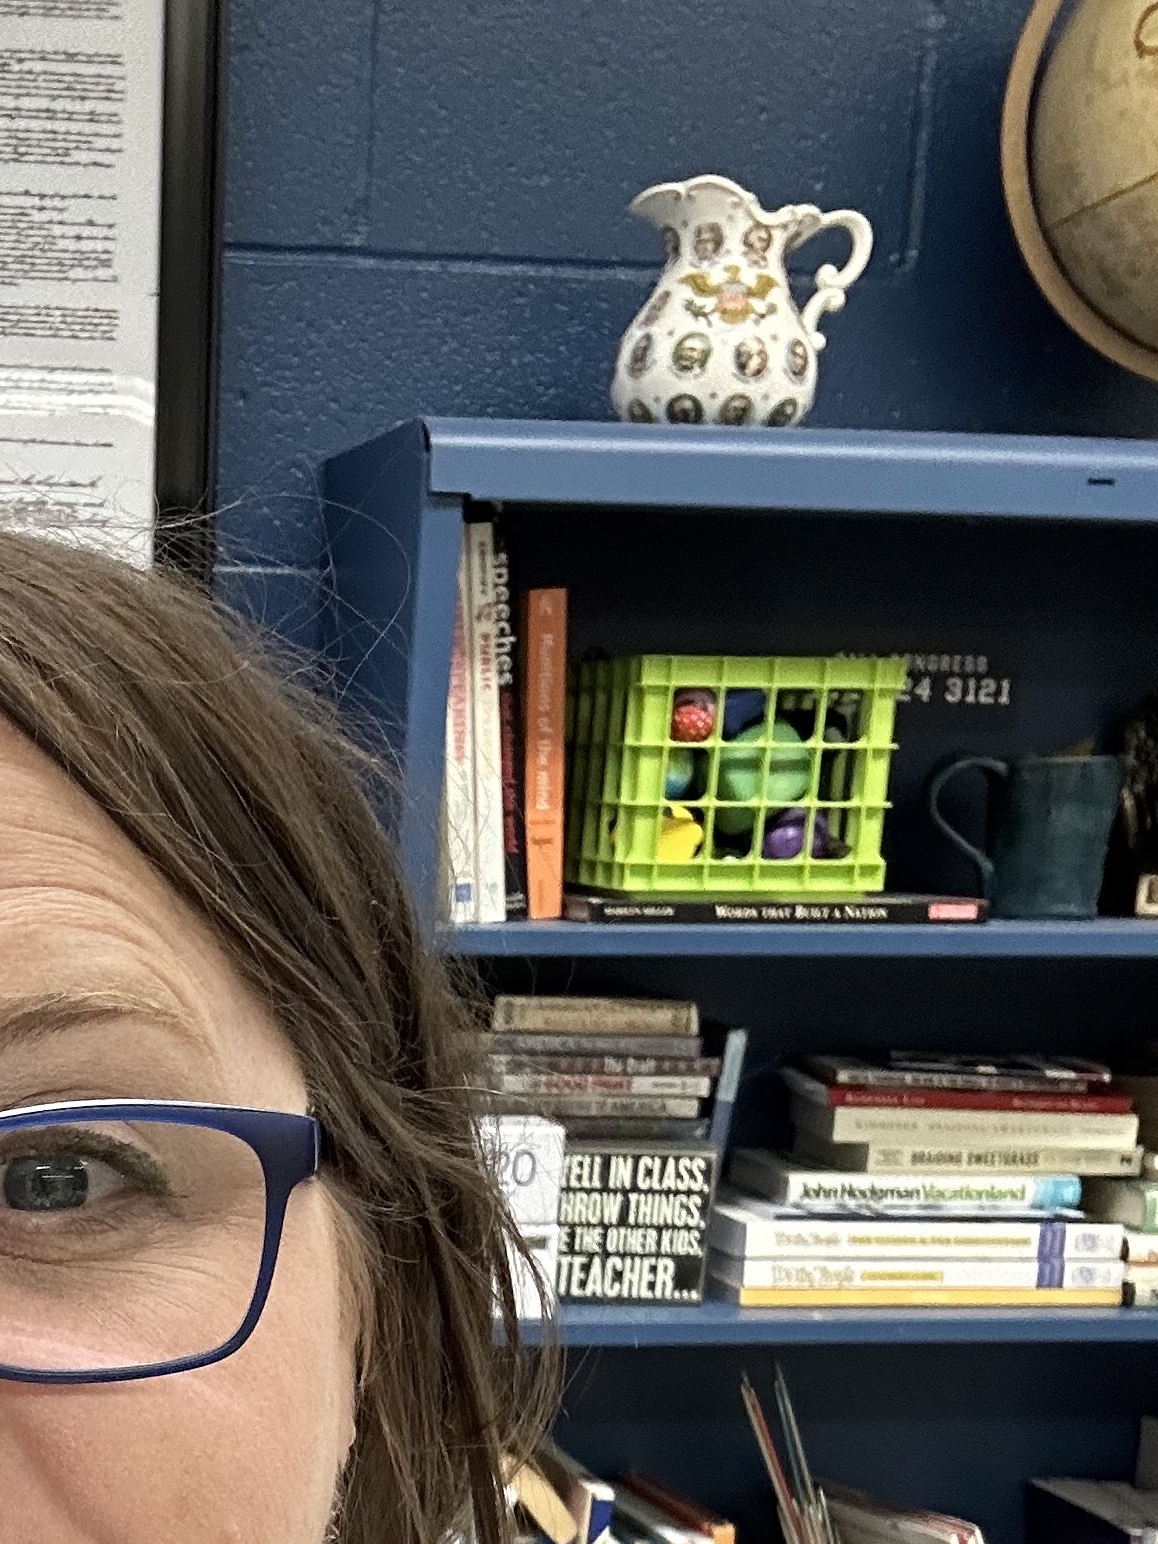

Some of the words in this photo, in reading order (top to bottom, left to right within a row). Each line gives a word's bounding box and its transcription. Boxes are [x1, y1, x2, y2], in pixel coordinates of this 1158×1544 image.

[493, 552, 517, 686] speeches
[944, 677, 1011, 705] 3121
[608, 1156, 634, 1190] IN
[637, 1156, 710, 1194] CLASS.
[800, 1182, 839, 1201] John
[627, 1193, 706, 1230] THINGS.
[574, 1227, 603, 1251] THE
[606, 1228, 658, 1253] OTHER
[661, 1229, 704, 1257] KIDS.
[558, 1255, 700, 1300] TEACHER...
